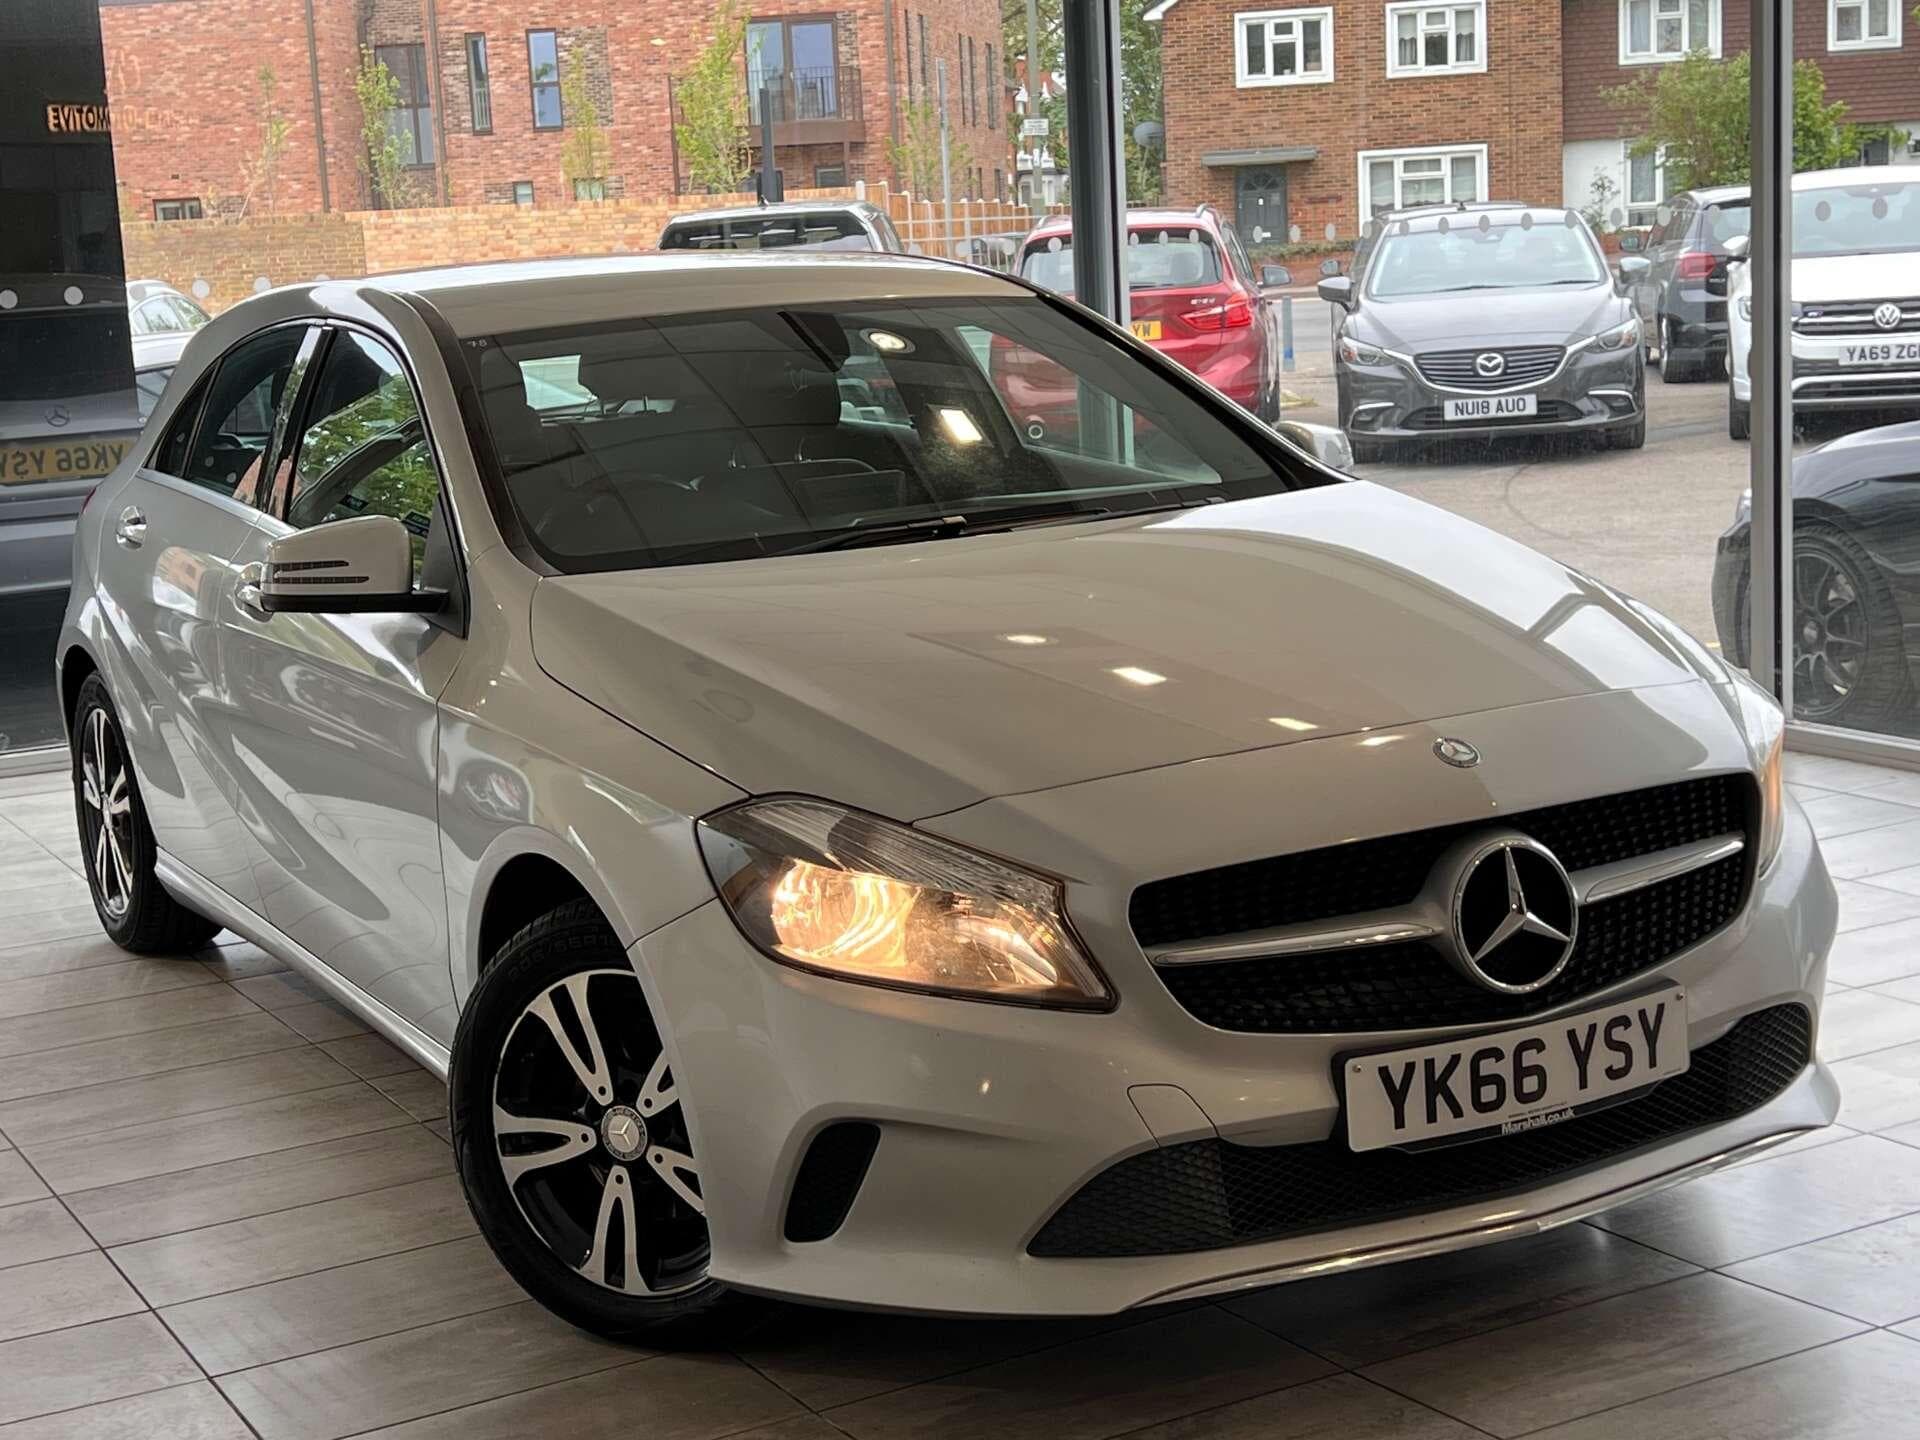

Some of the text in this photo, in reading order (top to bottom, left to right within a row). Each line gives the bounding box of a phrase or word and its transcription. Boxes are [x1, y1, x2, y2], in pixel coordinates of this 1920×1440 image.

[1132, 323, 1151, 337] YW
[1846, 344, 1920, 361] YA69 ZG
[1454, 397, 1527, 417] NU18 AUO
[1377, 1002, 1666, 1131] YK66 YSY
